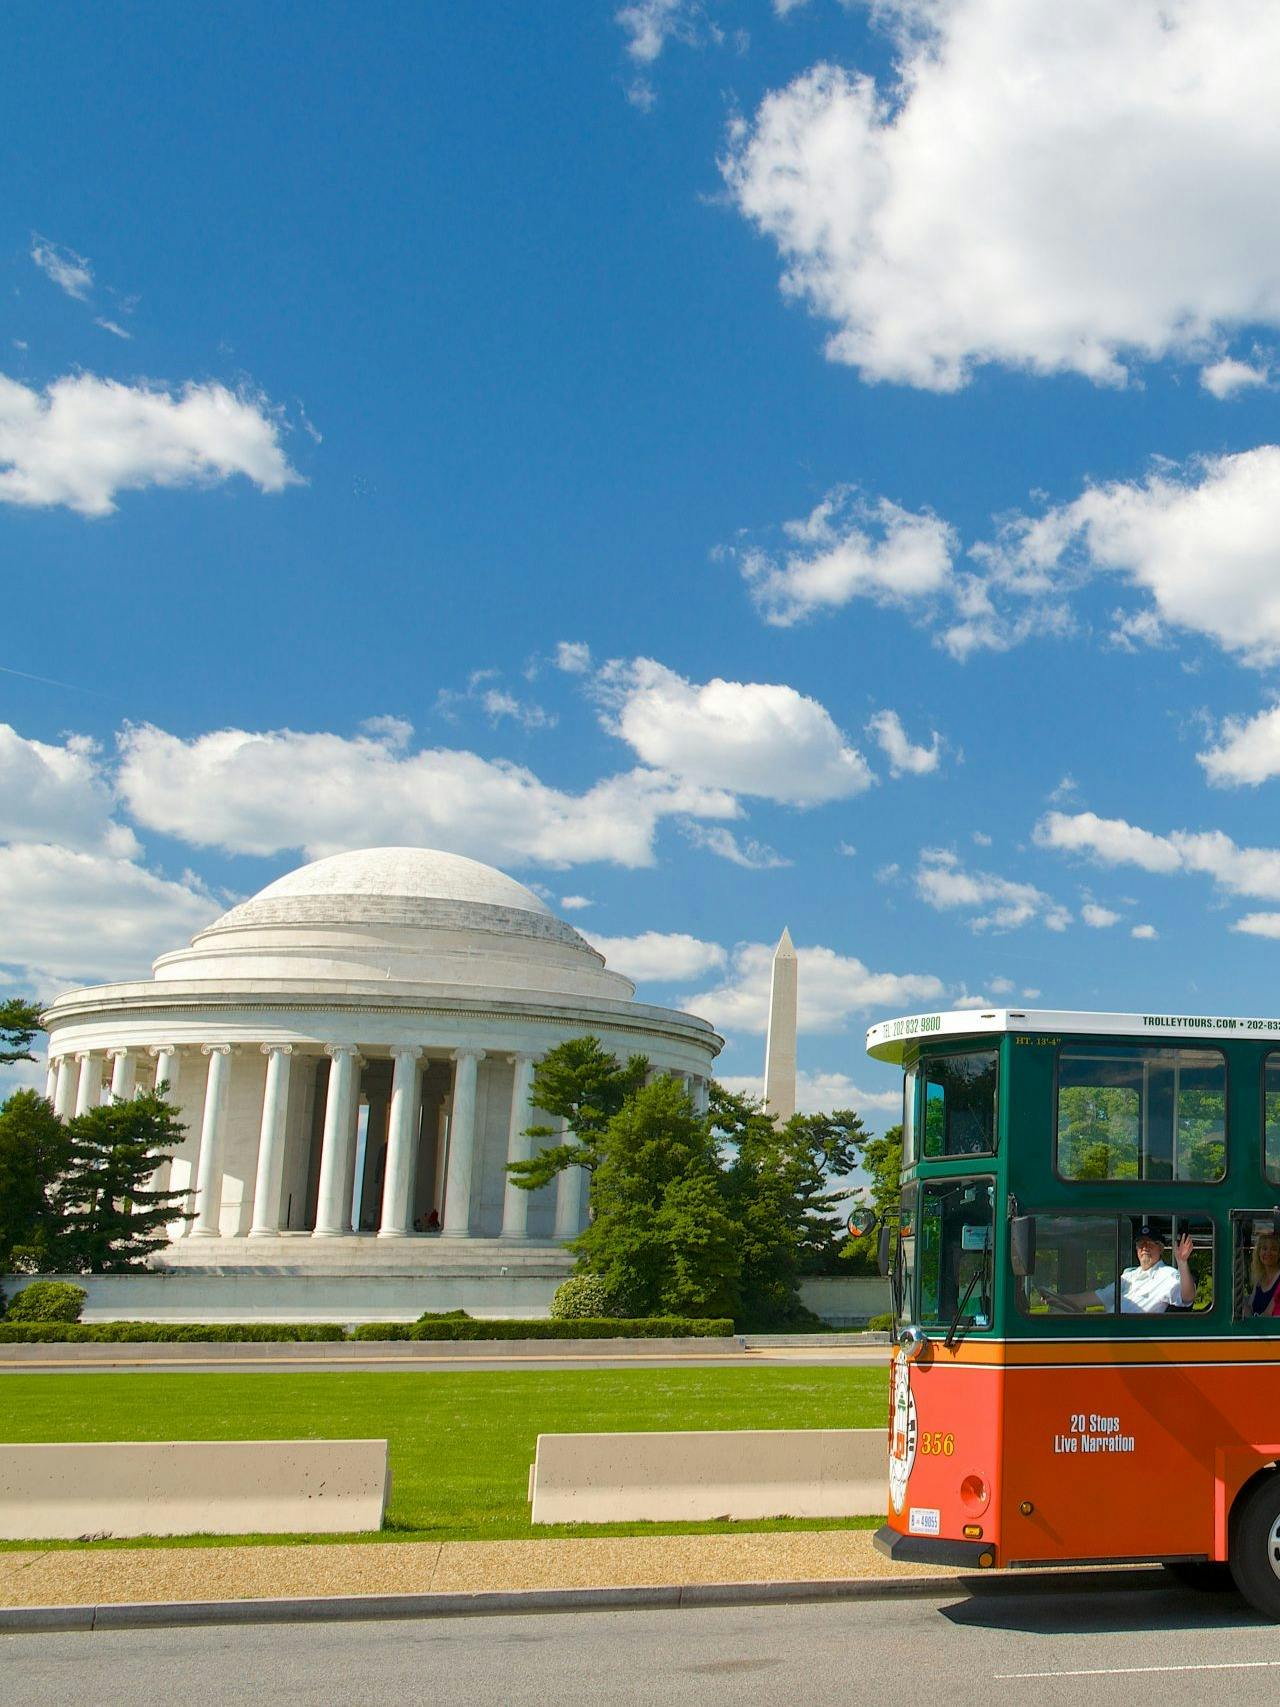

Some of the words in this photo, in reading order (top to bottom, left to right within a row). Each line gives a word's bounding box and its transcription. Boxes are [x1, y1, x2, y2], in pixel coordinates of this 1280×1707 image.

[1143, 1016, 1237, 1029] TROLLEYTOURS.COM
[1071, 1414, 1086, 1433] 20
[1089, 1414, 1120, 1434] Stops
[921, 1431, 955, 1457] 356
[1055, 1434, 1078, 1453] Live
[1081, 1434, 1135, 1453] Narration
